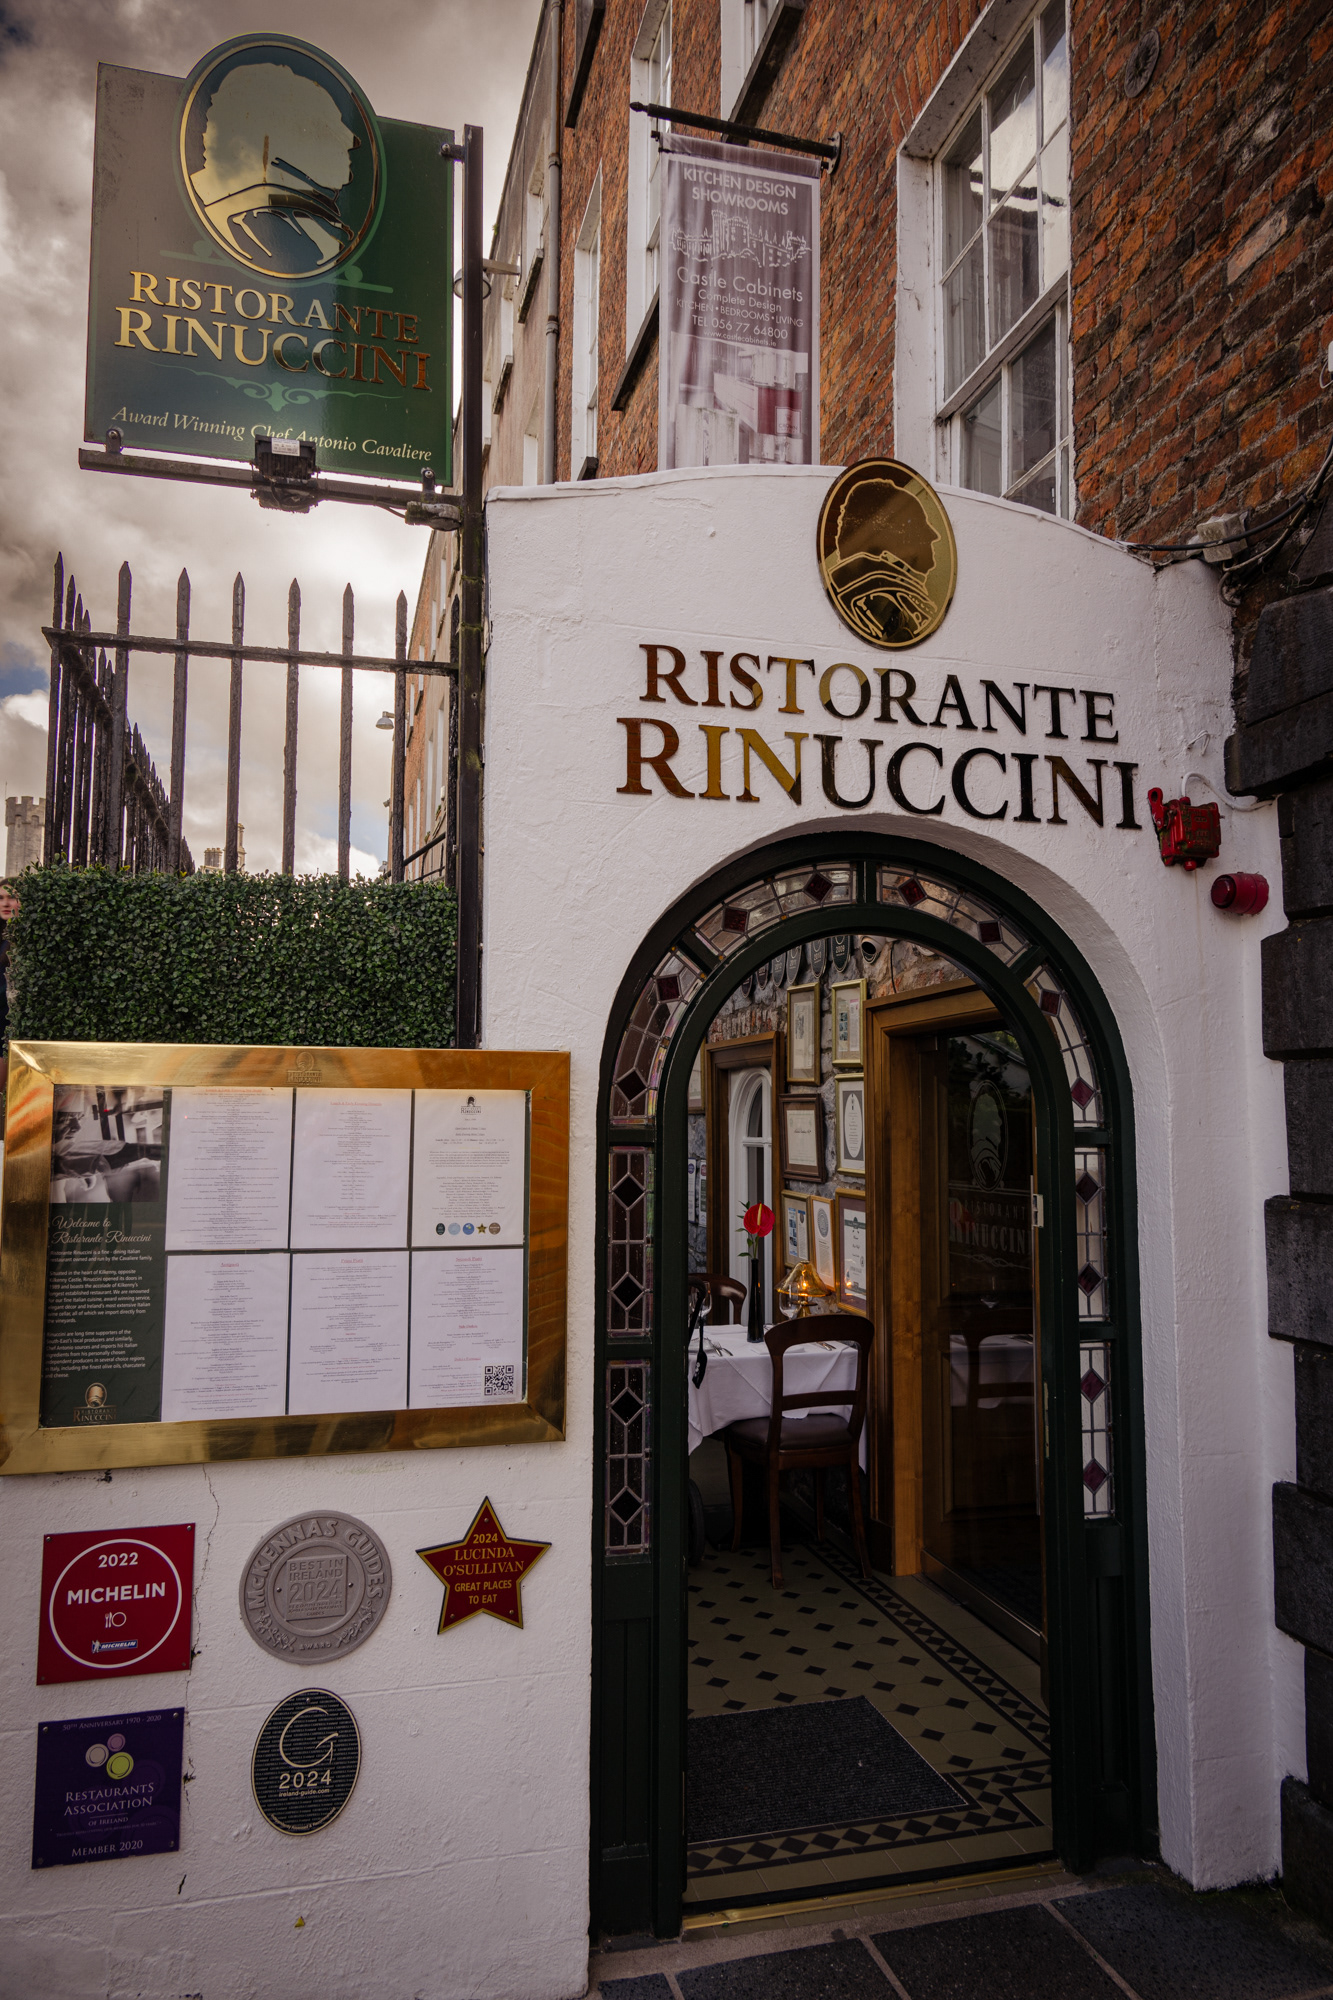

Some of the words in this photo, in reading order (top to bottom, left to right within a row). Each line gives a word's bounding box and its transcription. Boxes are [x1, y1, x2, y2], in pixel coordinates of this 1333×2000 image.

[684, 167, 741, 190] KITCHEN
[746, 178, 796, 199] DESIGN
[692, 186, 788, 215] SHOWROOMS
[677, 266, 727, 289] Castle
[733, 276, 803, 302] Cabinets
[129, 270, 420, 345] RISTORANTE
[698, 289, 745, 305] Complete
[748, 297, 781, 313] Design
[676, 298, 713, 312] KITCHEN
[720, 305, 770, 321] BEDROOMS
[775, 315, 804, 328] LIVING
[692, 314, 708, 327] TEL
[711, 318, 732, 331] 056
[735, 322, 751, 333] 77
[753, 325, 788, 339] 64800
[114, 306, 433, 393] RINUCCINI
[111, 406, 170, 427] Award
[173, 413, 246, 442] Winning
[250, 424, 293, 440] Chef
[296, 430, 357, 451] Antonio
[362, 439, 432, 462] Cavaliere
[639, 643, 1119, 745] RISTORANTE
[615, 716, 1143, 830] RINUCCINI
[52, 1216, 100, 1229] Welcome
[102, 1218, 112, 1227] to
[51, 1231, 102, 1244] Ristorante
[105, 1231, 152, 1242] Rinuccini
[473, 1533, 498, 1544] 2024
[98, 1552, 139, 1568] 2022
[344, 1528, 385, 1600] GUIDES
[454, 1547, 515, 1561] LUCINDA
[290, 1561, 325, 1571] BEST
[329, 1559, 343, 1568] IN
[290, 1569, 343, 1581] IRELAND
[443, 1561, 524, 1577] O'SULLIVAN
[66, 1581, 166, 1606] MICHELIN
[290, 1579, 342, 1603] 2024
[454, 1582, 481, 1592] GREAT
[483, 1580, 512, 1591] PLACES
[468, 1595, 479, 1604] TO
[482, 1594, 498, 1604] EAT
[101, 1641, 137, 1649] MICHELIN
[79, 1719, 124, 1730] ANNIVERSARY
[126, 1716, 141, 1724] 1970
[147, 1714, 162, 1723] 2020
[279, 1769, 332, 1789] 2024
[65, 1782, 155, 1803] RESTAURANTS
[278, 1788, 330, 1797] ireland-guide.com
[63, 1796, 153, 1816] ASSOCIATION
[99, 1816, 129, 1825] IRELAND
[71, 1844, 116, 1857] MEMBER
[119, 1839, 143, 1852] 2020
